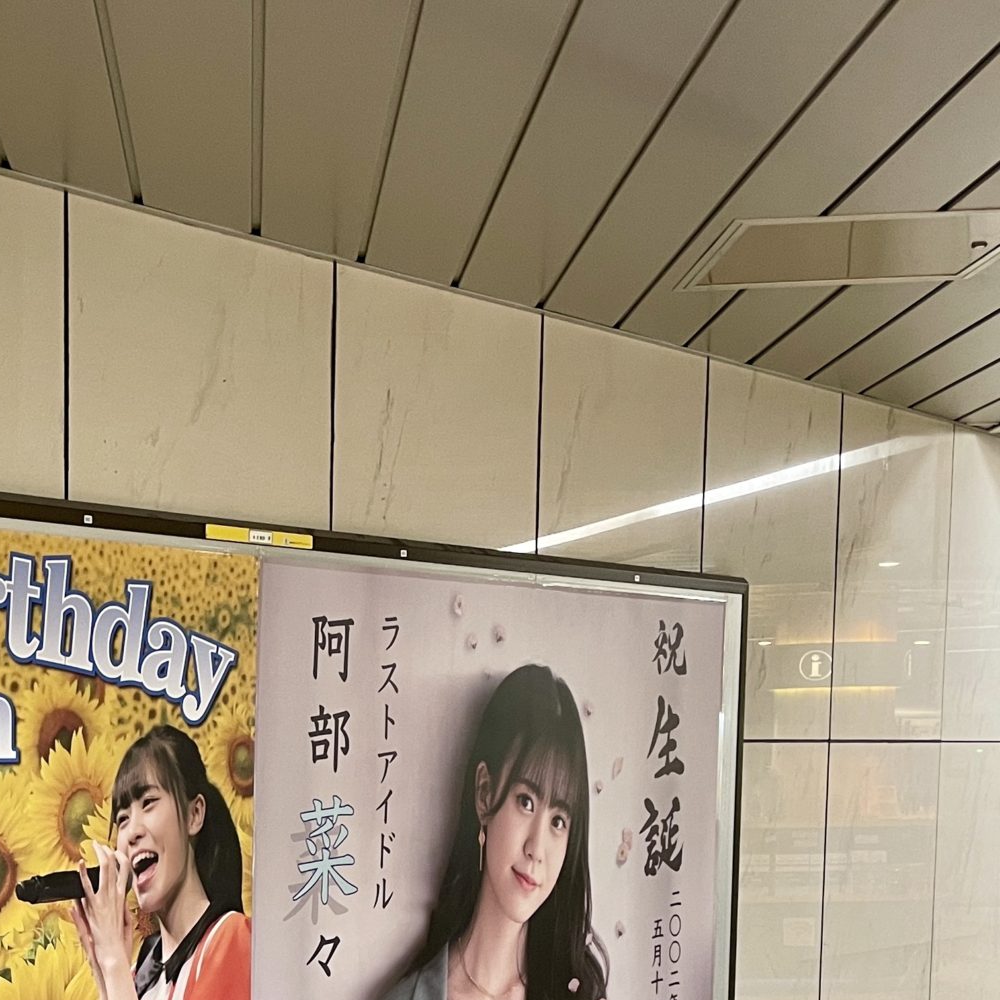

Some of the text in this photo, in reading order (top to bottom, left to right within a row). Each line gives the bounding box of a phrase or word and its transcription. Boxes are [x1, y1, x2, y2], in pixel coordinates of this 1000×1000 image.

[373, 615, 400, 911] ラストアイドル
[639, 619, 688, 878] 祝生誕
